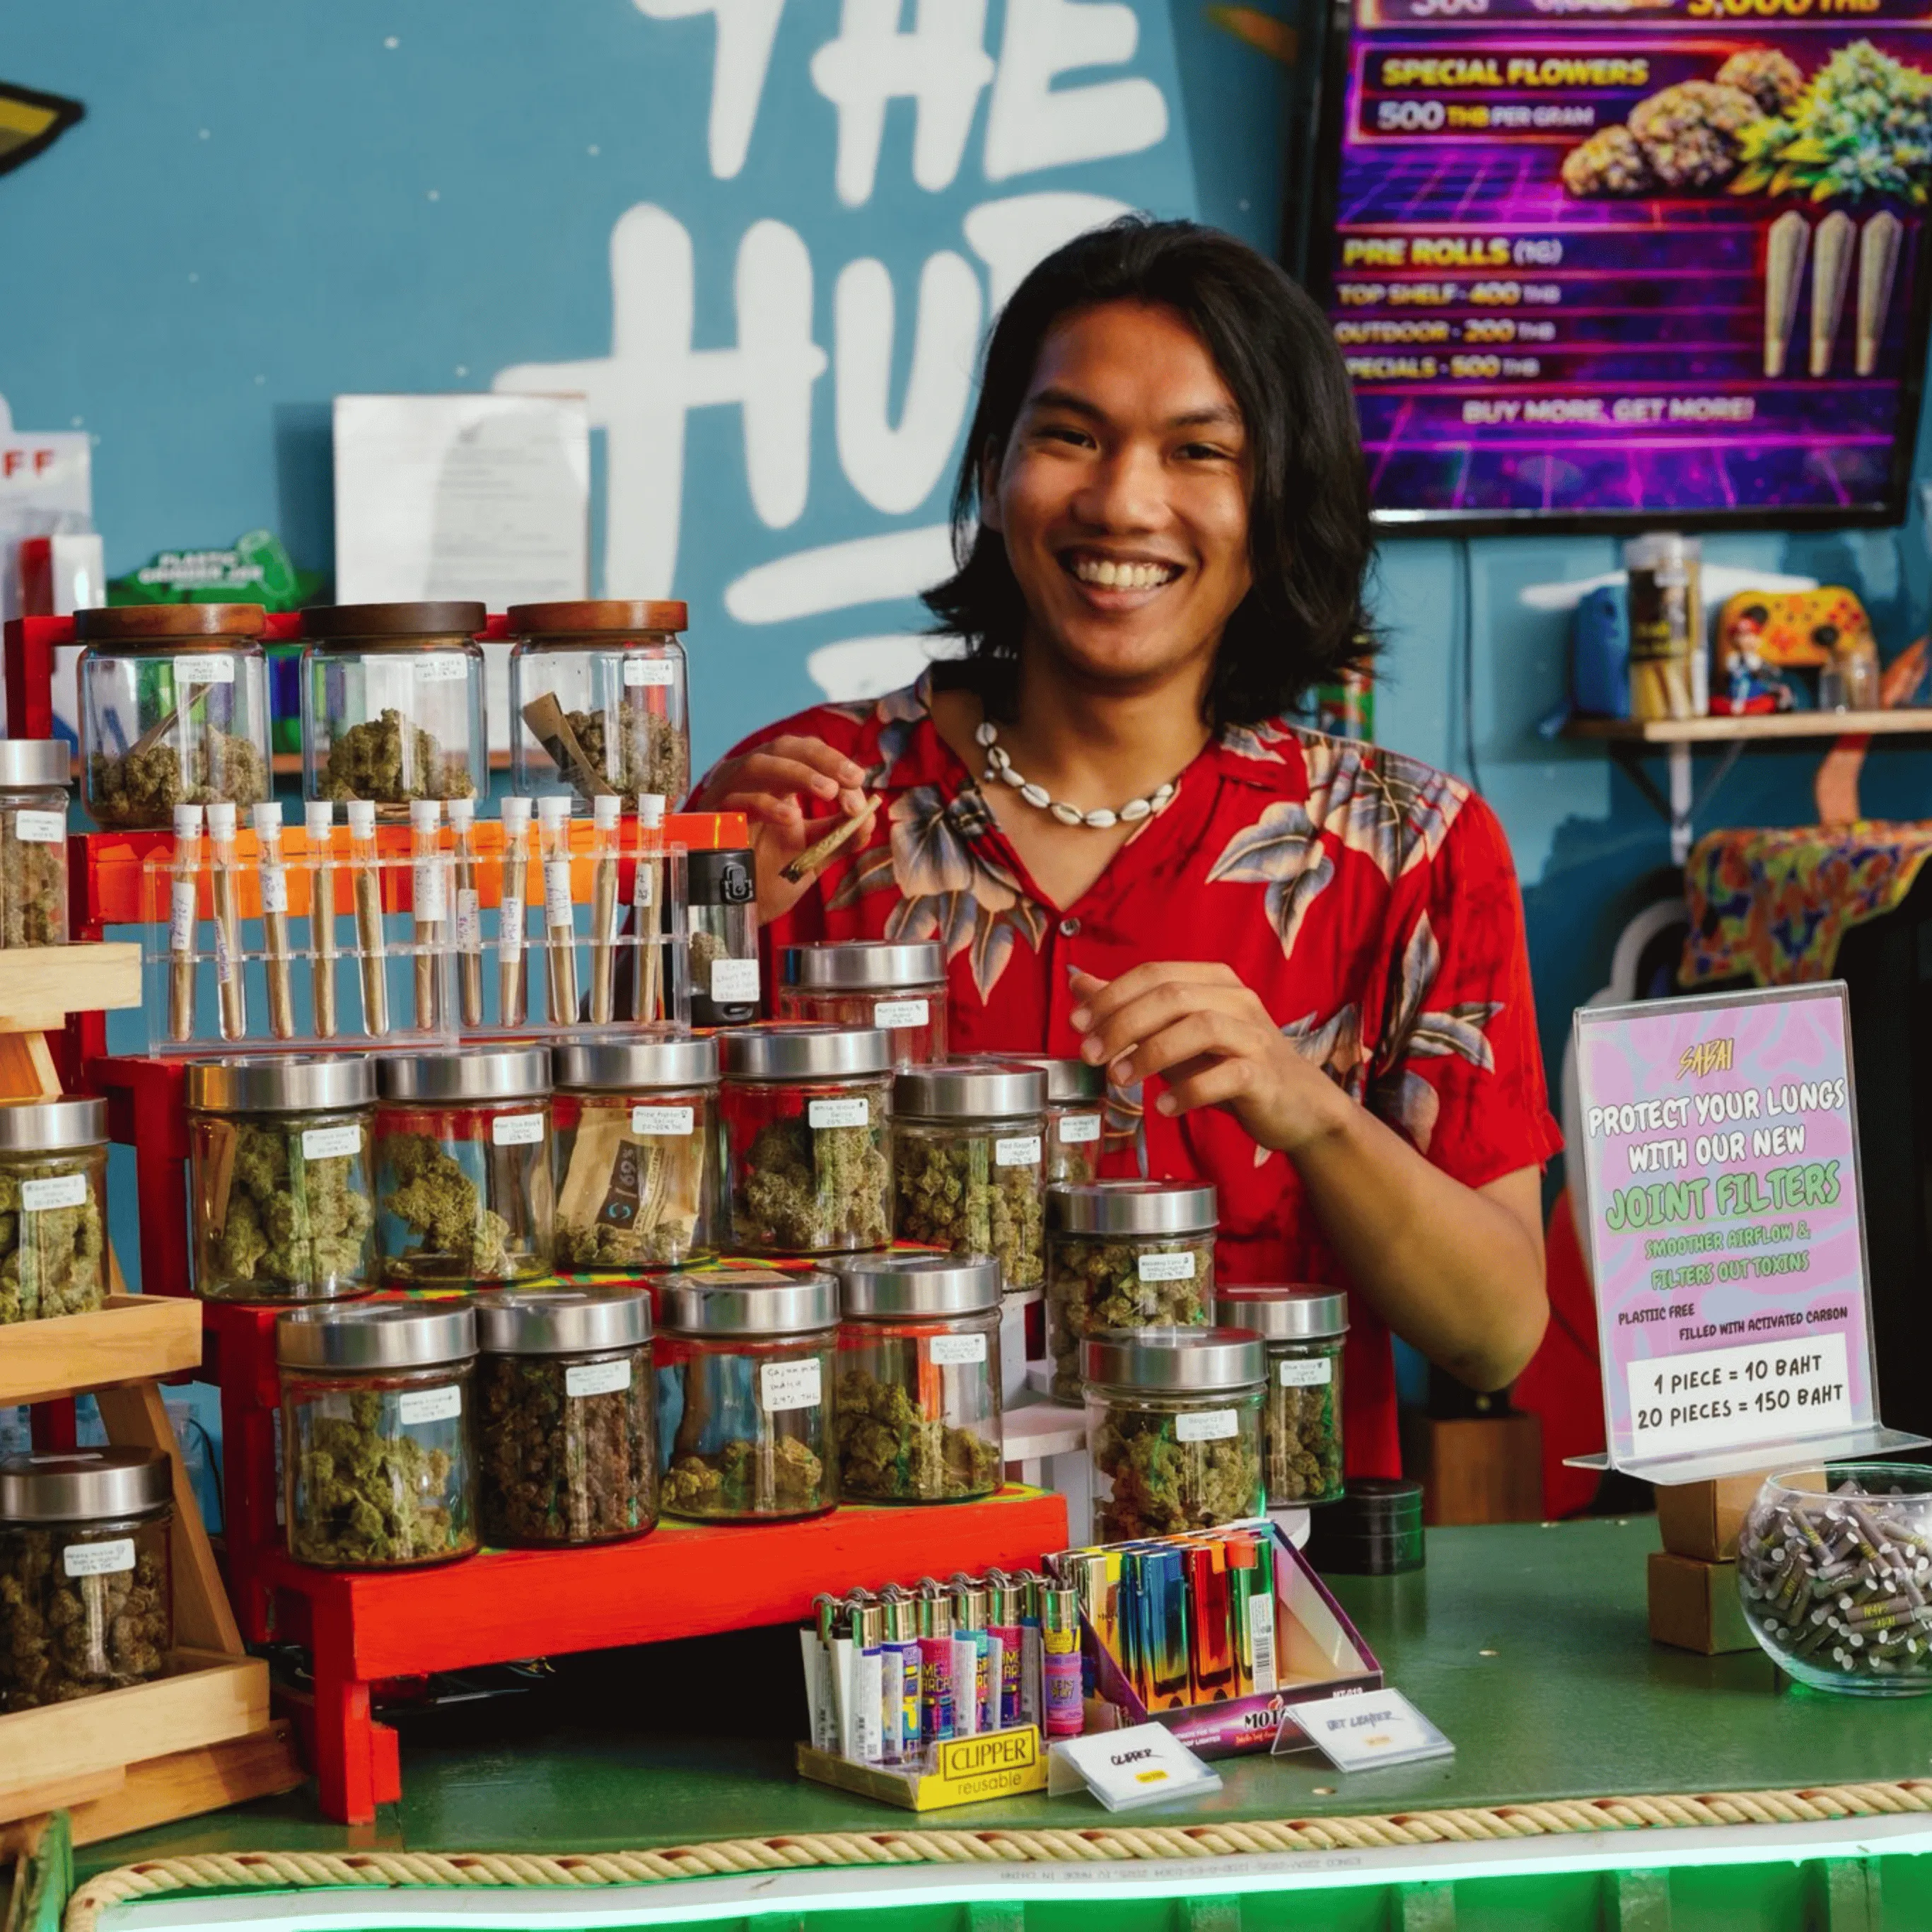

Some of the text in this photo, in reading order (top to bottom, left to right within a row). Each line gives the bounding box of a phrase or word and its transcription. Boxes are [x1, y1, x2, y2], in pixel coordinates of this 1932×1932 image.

[1382, 59, 1649, 86] SPECIAL FLOWERS
[633, 0, 1168, 206] THE
[1378, 101, 1595, 130] 500 THB PER GRAM
[1344, 238, 1407, 267] PRE
[1412, 237, 1511, 266] ROLLS
[1339, 284, 1387, 305] TOP
[1388, 283, 1457, 305] SHELF
[1469, 281, 1520, 305] 400
[1523, 285, 1561, 304] THB
[1334, 320, 1450, 343] OUTDOOR
[1463, 319, 1515, 342] 200
[1518, 321, 1556, 341] THB
[1344, 356, 1437, 378] PECIALS
[1450, 354, 1501, 378] 500
[1502, 357, 1540, 377] THB
[1462, 399, 1521, 424] BUY
[1612, 398, 1665, 423] GET
[1588, 1078, 1845, 1138] PROTECT YOUR LUNGS
[1629, 1124, 1805, 1173] WITH OUR NEW
[1606, 1160, 1839, 1230] JOINT FILTERS
[1645, 1221, 1811, 1260] SMOOTHER AIRFLOW &
[1651, 1250, 1810, 1291] FILTERS OUT TOXINS
[1669, 1303, 1695, 1319] FREE
[1680, 1306, 1849, 1341] FILLED WITH ACTIVATED CARBON
[1653, 1354, 1822, 1395] 1 PIECE = 10 BAHT
[1638, 1384, 1844, 1430] 20 PIECES = 150 BAHT
[951, 1738, 1025, 1771] CLIPPER
[958, 1771, 1022, 1796] reusable
